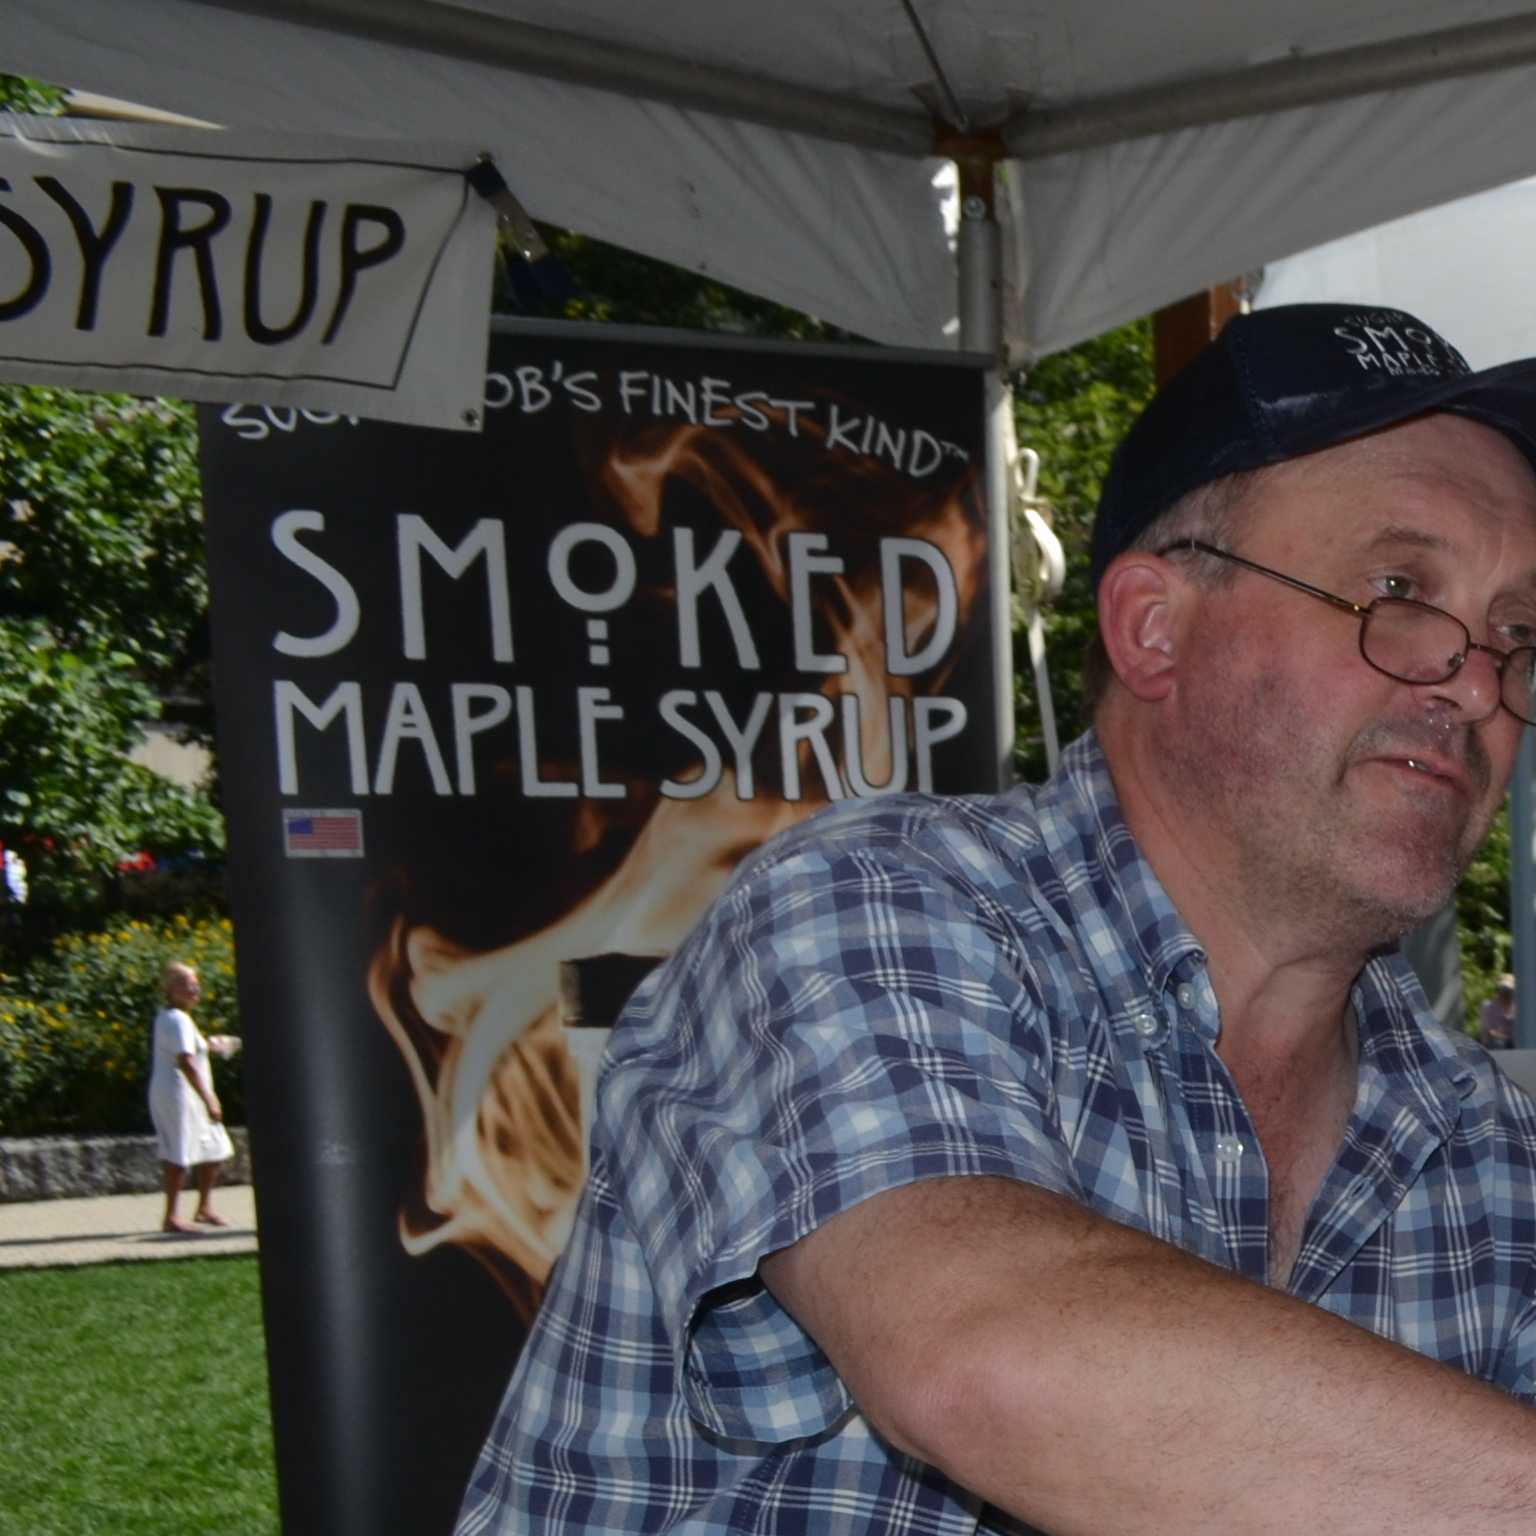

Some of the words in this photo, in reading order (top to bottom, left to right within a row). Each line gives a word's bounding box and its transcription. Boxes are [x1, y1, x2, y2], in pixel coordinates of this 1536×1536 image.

[484, 362, 601, 412] OB'S
[618, 369, 817, 438] FINEST
[270, 509, 959, 677] SMOKED
[273, 681, 627, 798] MAPLE
[659, 690, 968, 801] SYRUP
